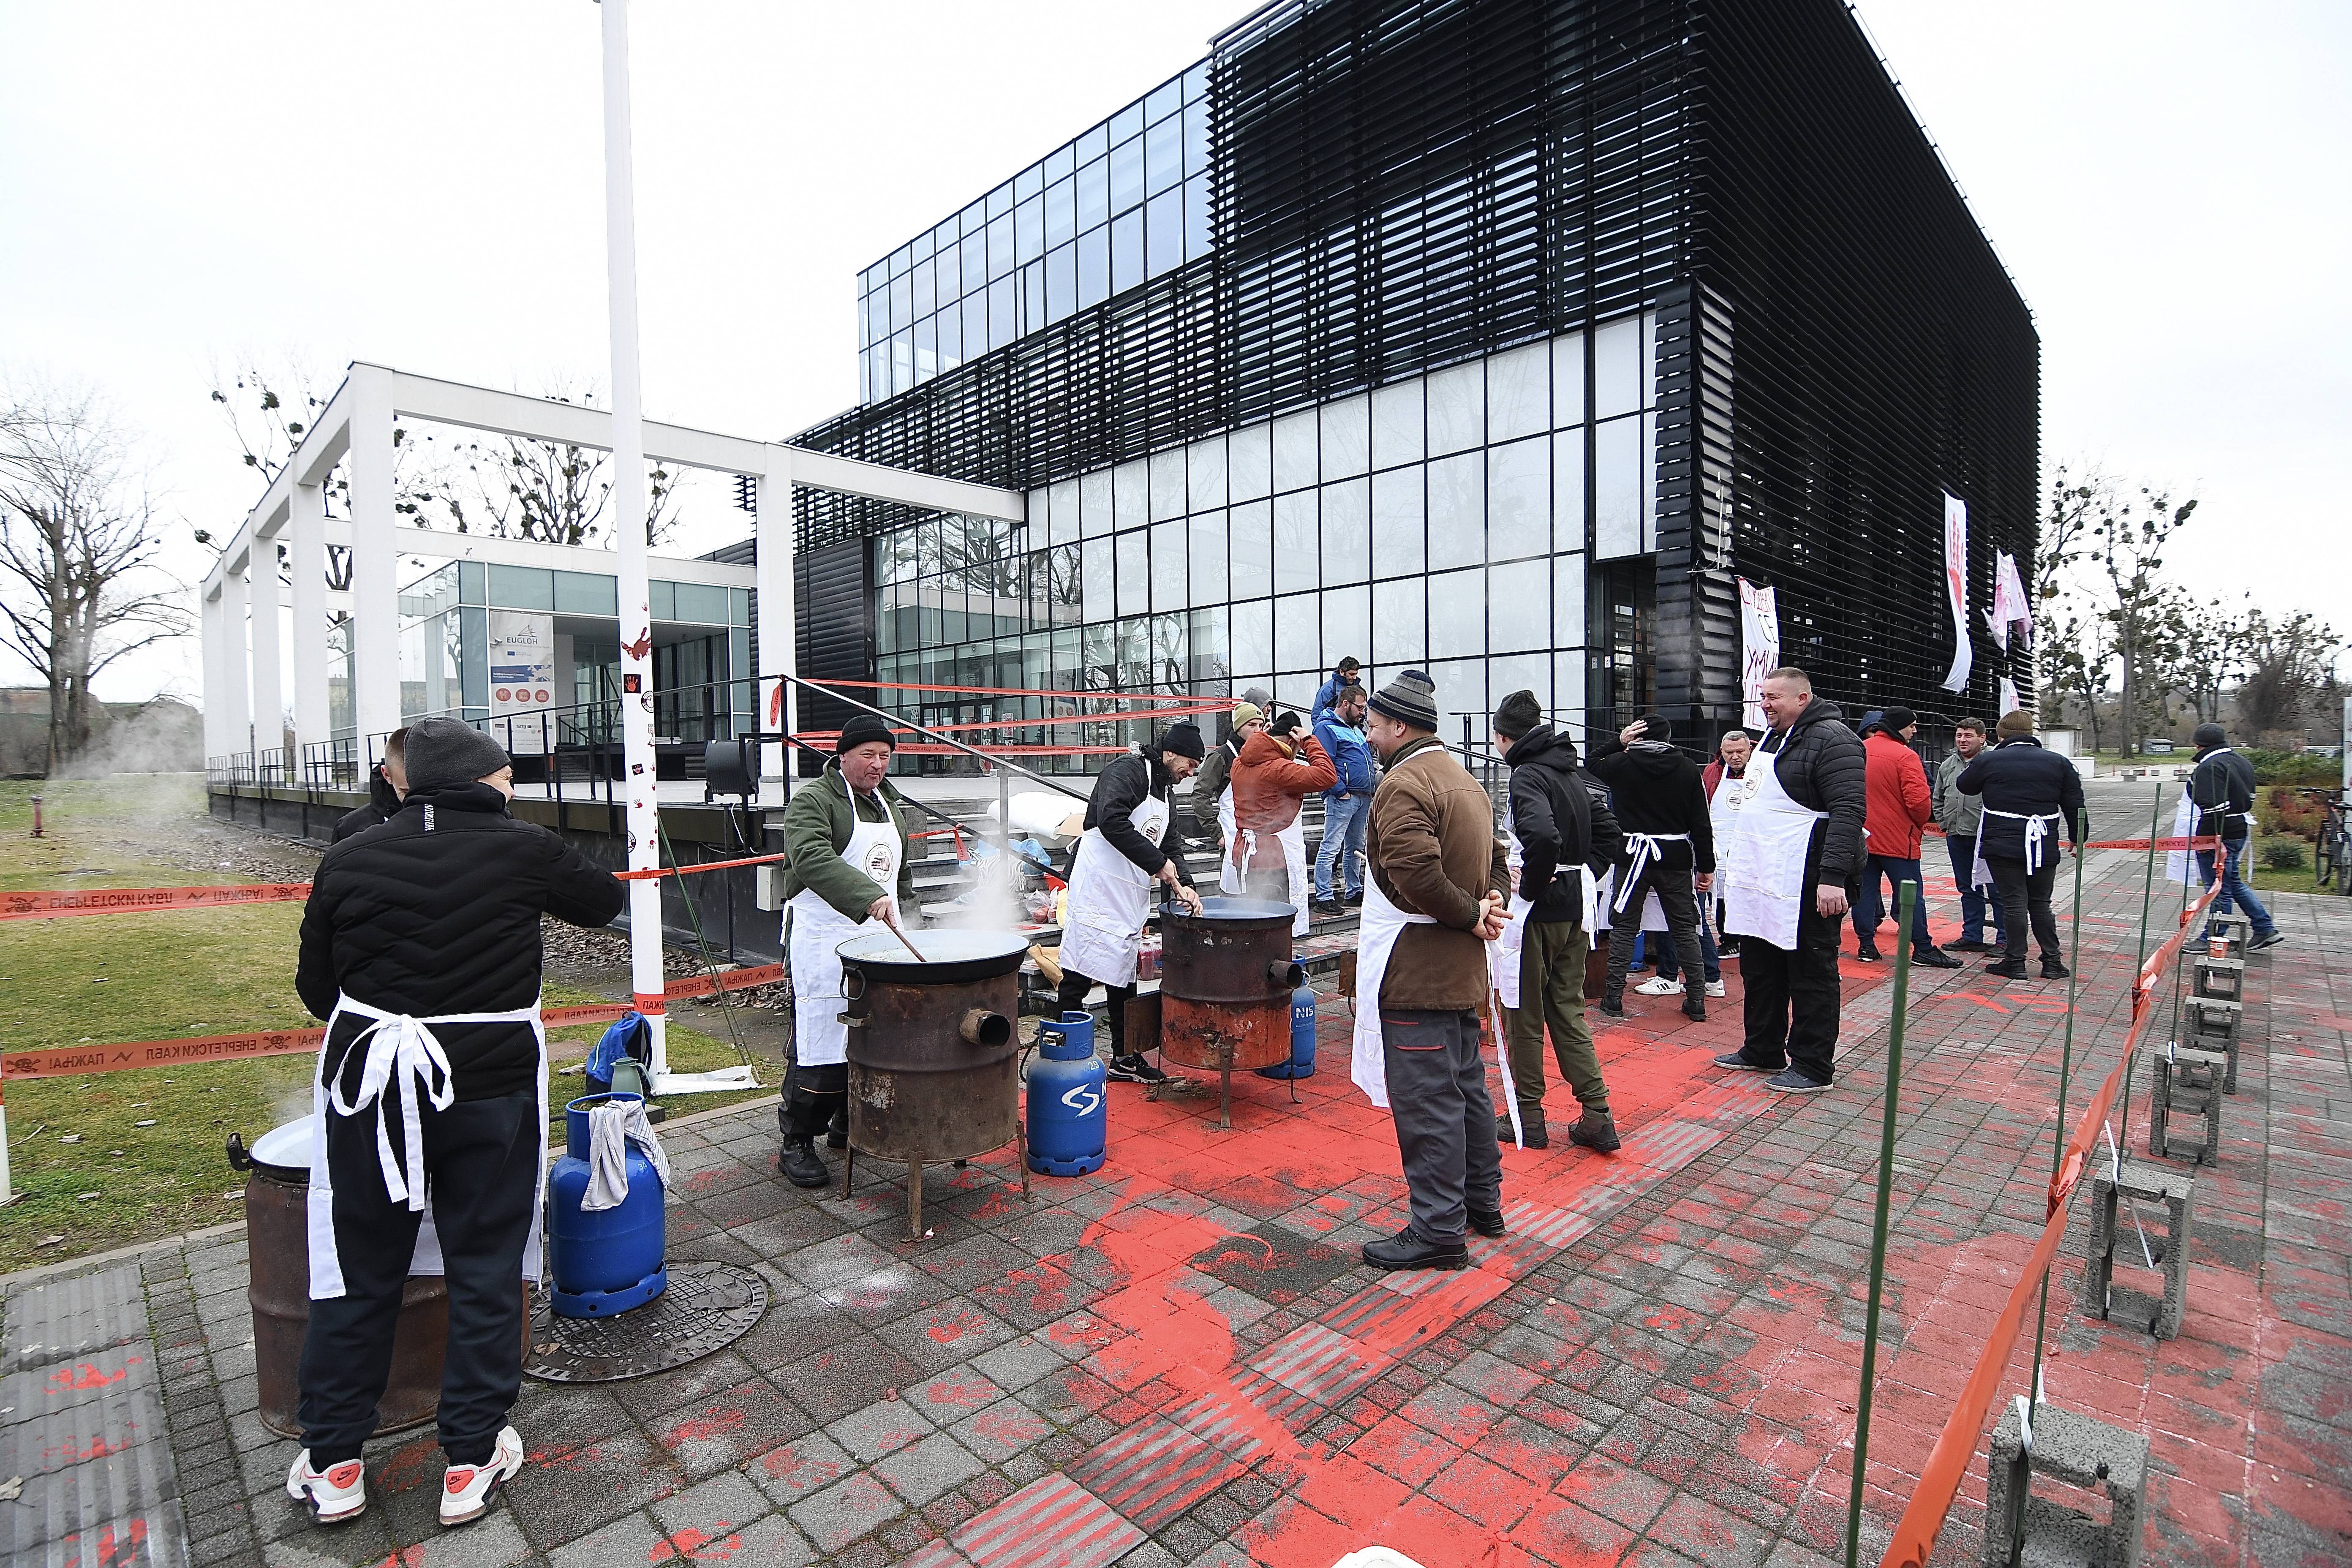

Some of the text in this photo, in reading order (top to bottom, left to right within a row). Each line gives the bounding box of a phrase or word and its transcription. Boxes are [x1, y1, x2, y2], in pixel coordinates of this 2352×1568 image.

[506, 637, 538, 645] EUGLOH
[1746, 645, 1778, 680] УМИ
[1296, 1005, 1314, 1018] NIS
[1088, 1061, 1100, 1070] 29
[637, 1160, 648, 1171] 34
